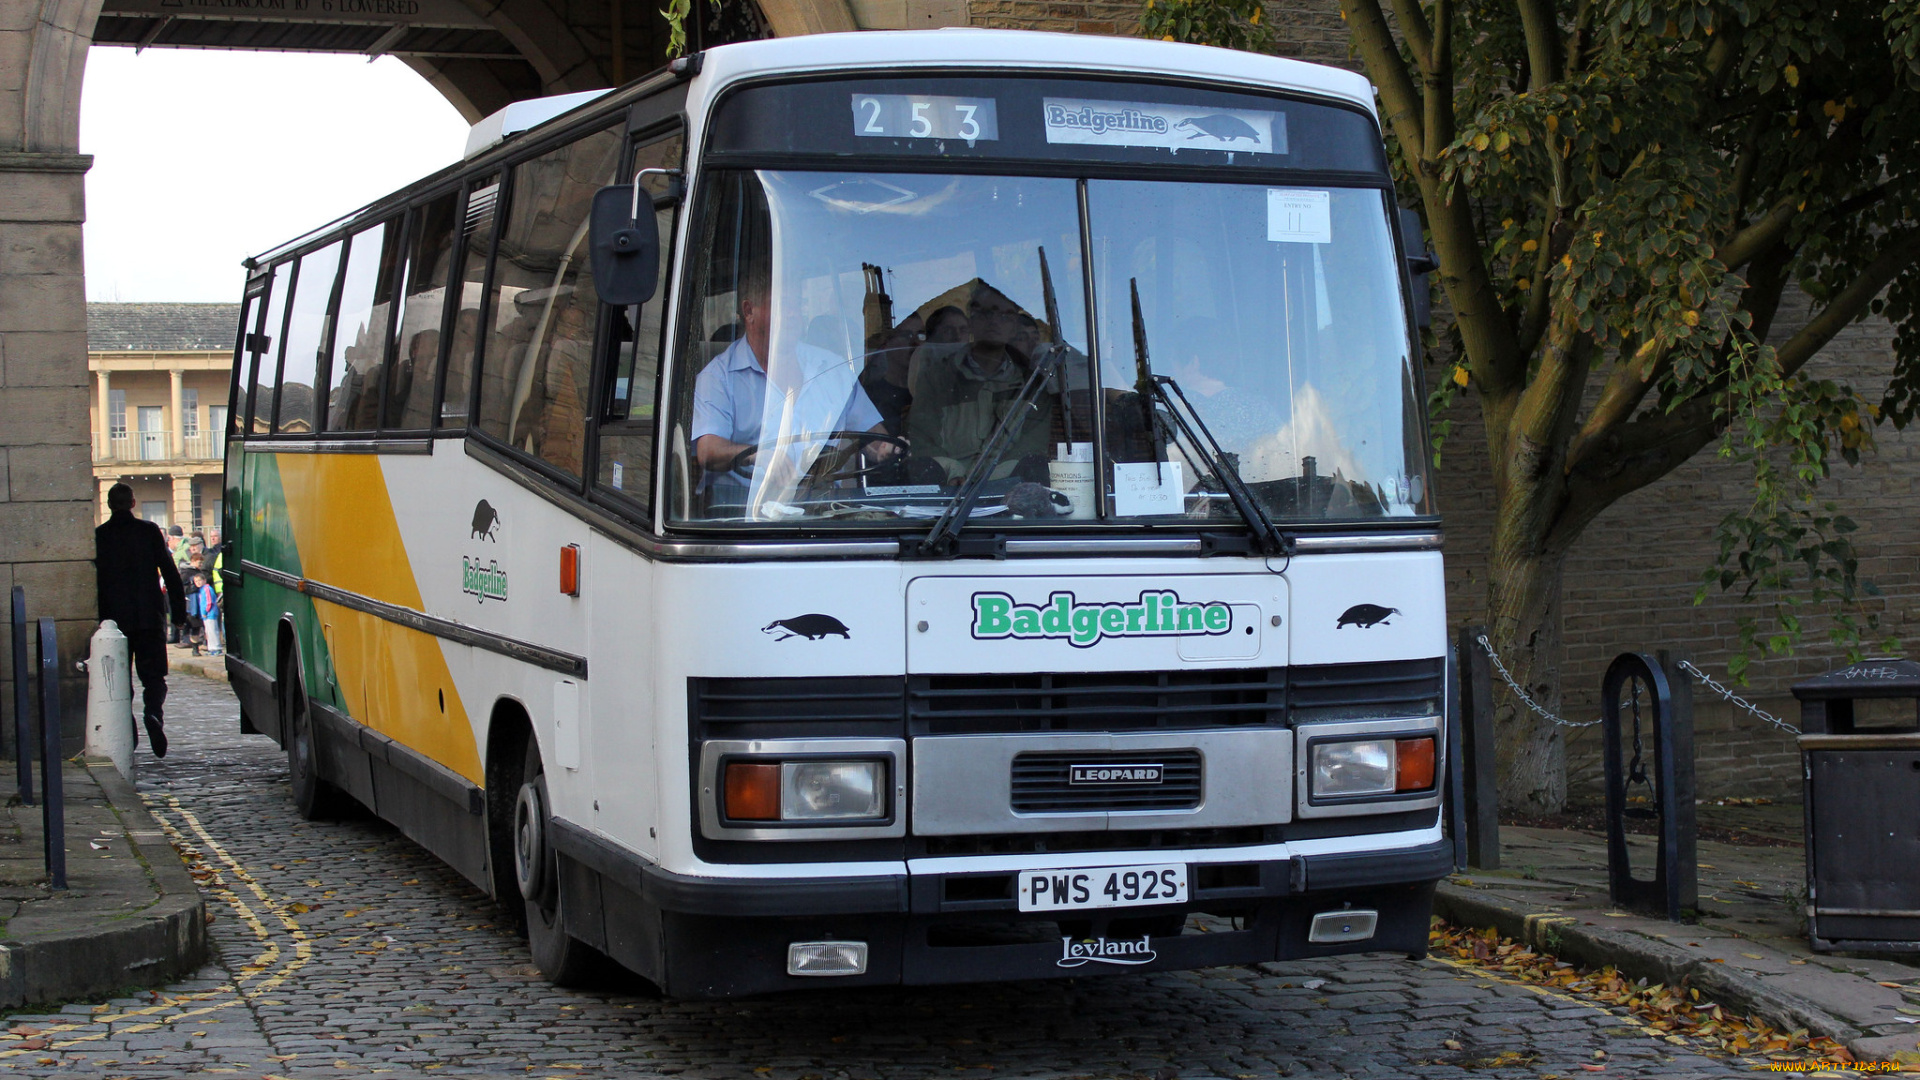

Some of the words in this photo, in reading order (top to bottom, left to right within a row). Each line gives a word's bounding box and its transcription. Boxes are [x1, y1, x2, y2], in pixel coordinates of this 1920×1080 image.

[339, 0, 419, 14] LOWERED
[859, 97, 884, 133] 2
[909, 102, 932, 138] 5
[955, 105, 981, 141] 3
[1048, 104, 1168, 135] Badgerline
[464, 558, 507, 602] Badgerline
[974, 592, 1230, 646] Badgerline
[1074, 769, 1159, 781] LEOPARD
[1031, 874, 1090, 906] PWS
[1103, 869, 1178, 902] 492S
[1057, 935, 1157, 966] Leyland
